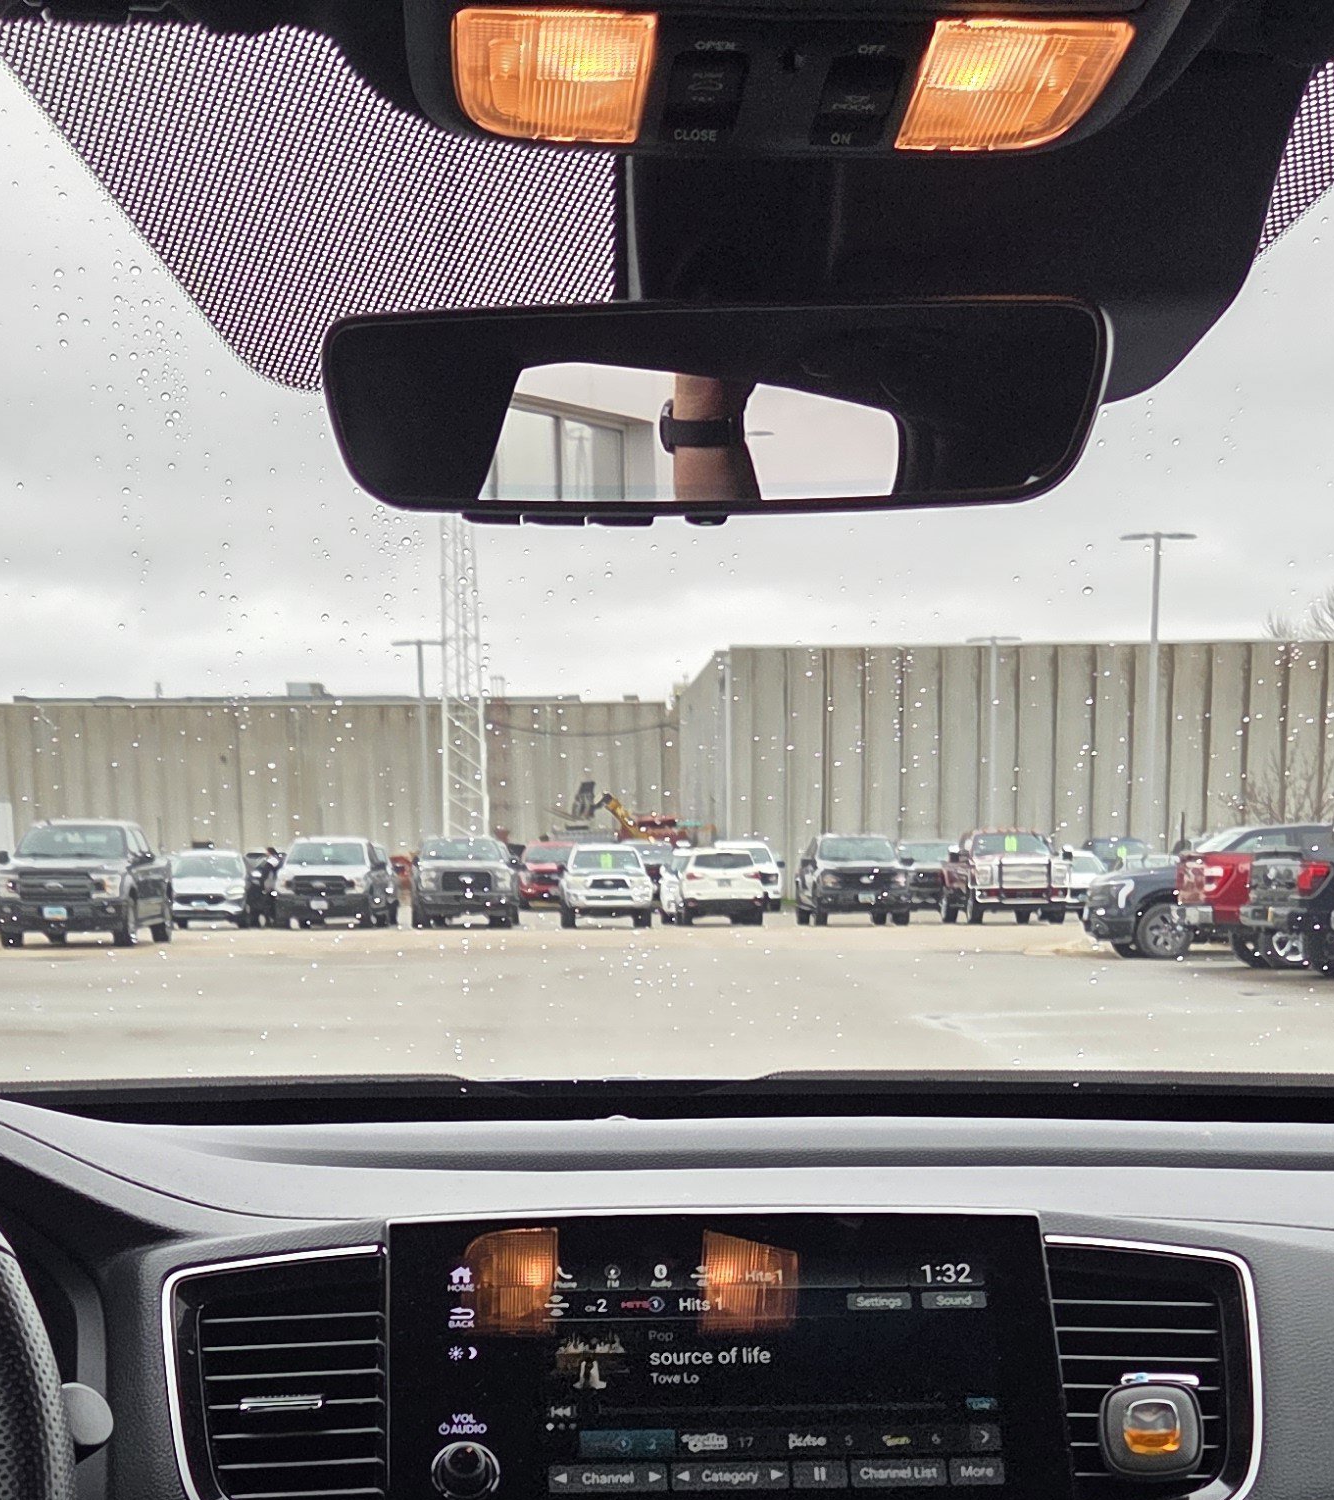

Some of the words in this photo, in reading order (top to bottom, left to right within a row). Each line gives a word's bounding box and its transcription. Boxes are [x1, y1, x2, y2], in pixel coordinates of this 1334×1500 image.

[858, 44, 886, 54] OFF
[674, 129, 718, 142] CLOSE
[830, 132, 852, 145] ON
[920, 1263, 973, 1284] 1:32
[447, 1283, 475, 1293] HOME
[597, 1298, 609, 1313] 2
[678, 1297, 711, 1311] Hits
[715, 1296, 723, 1311] 1
[856, 1296, 903, 1309] Settings
[935, 1294, 973, 1306] Sound
[447, 1319, 475, 1329] BACK
[649, 1351, 713, 1366] source
[718, 1348, 737, 1364] of
[742, 1346, 772, 1363] life
[650, 1372, 681, 1384] Tove
[683, 1371, 700, 1384] Lo
[452, 1412, 476, 1424] VOL
[450, 1423, 488, 1435] AUDIO
[736, 1436, 754, 1448] 17
[581, 1471, 635, 1485] Channel
[701, 1469, 759, 1485] Category
[859, 1466, 912, 1479] Channel
[913, 1465, 938, 1478] List
[960, 1465, 995, 1478] More
